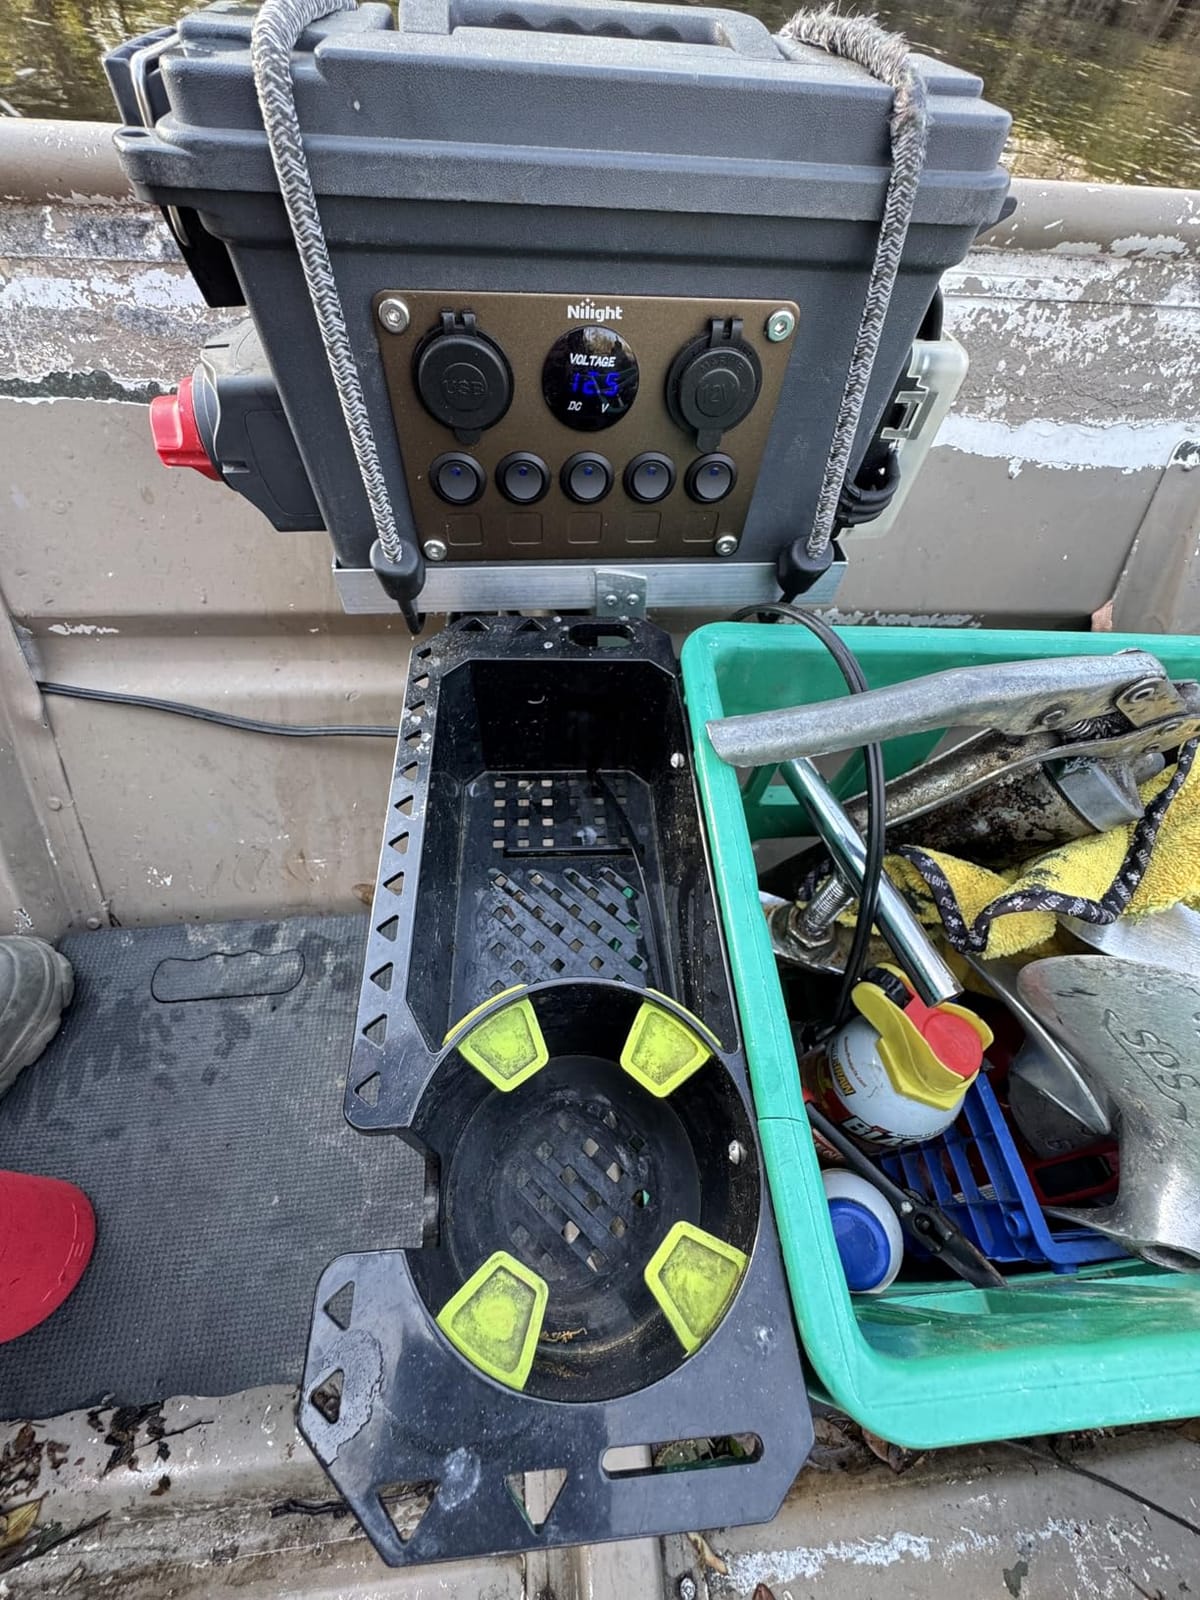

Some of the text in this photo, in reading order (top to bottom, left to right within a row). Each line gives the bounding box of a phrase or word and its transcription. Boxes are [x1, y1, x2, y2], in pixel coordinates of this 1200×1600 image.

[567, 299, 623, 322] Nilight
[569, 352, 617, 367] VOLTAGE
[442, 377, 484, 396] USB
[699, 383, 737, 402] 12V
[567, 400, 610, 414] DC V
